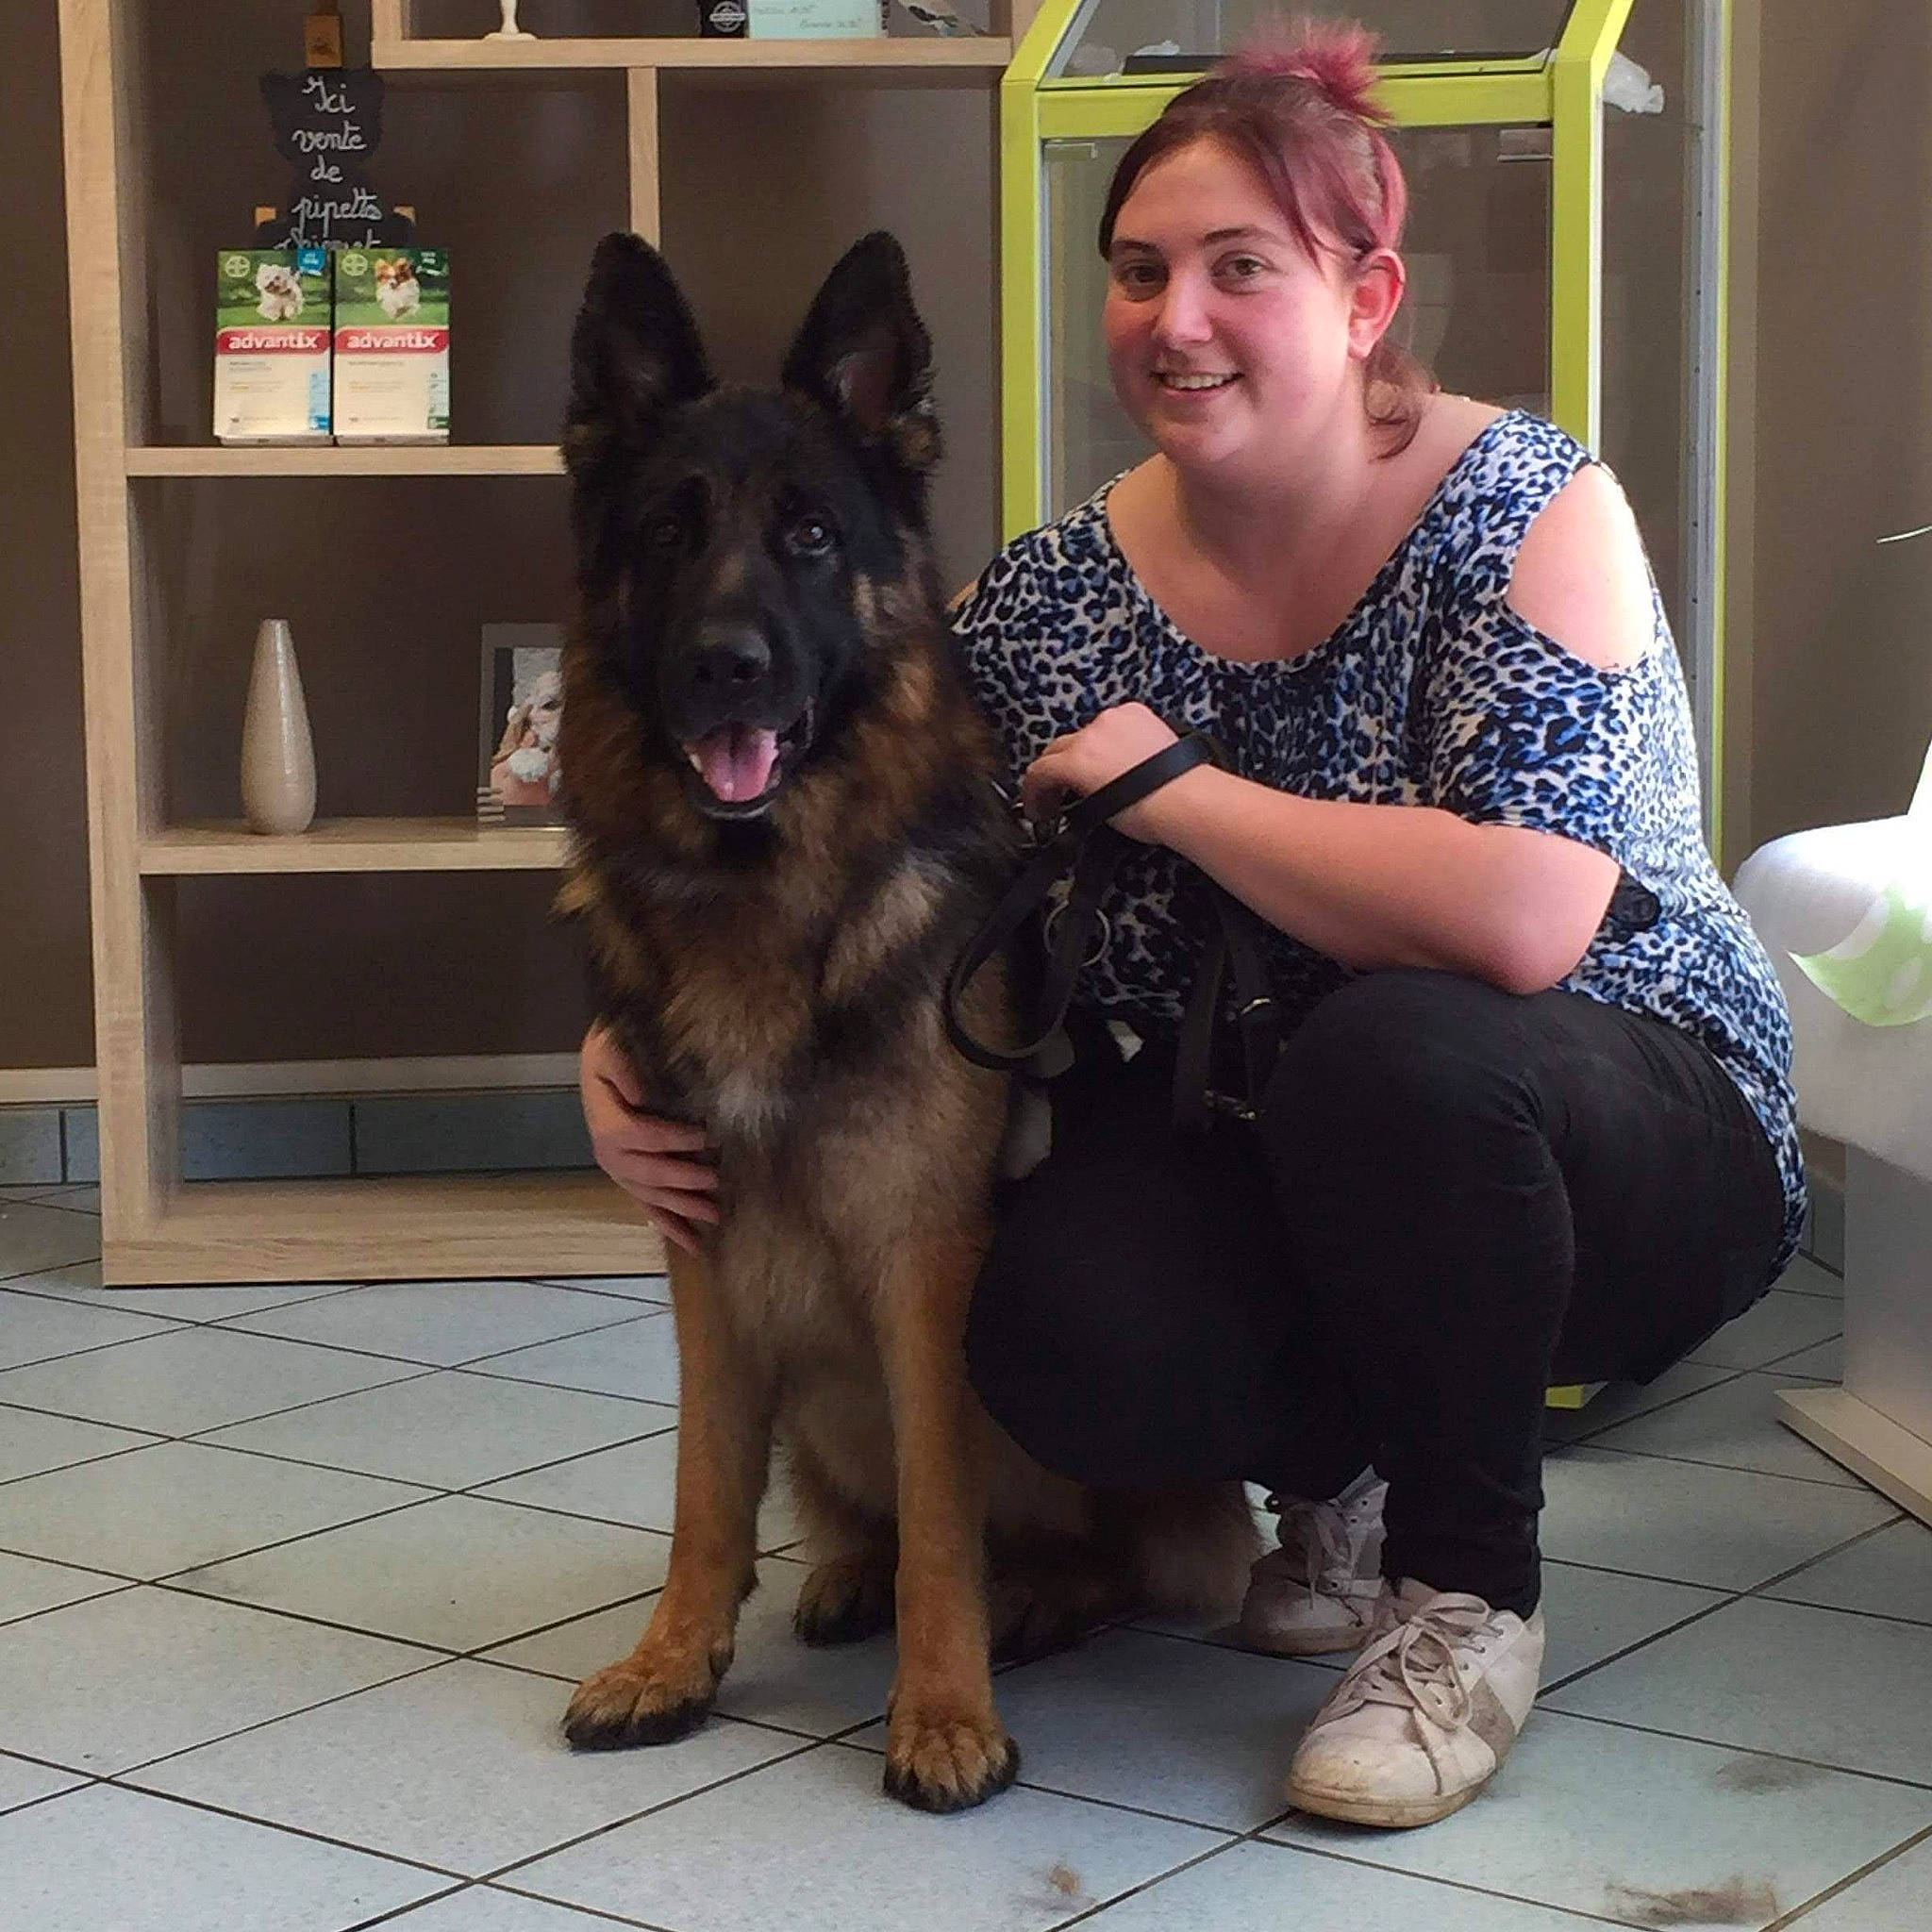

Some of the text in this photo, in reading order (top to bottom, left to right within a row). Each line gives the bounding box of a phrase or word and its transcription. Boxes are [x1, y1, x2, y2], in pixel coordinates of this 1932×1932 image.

[291, 119, 367, 152] vente
[309, 154, 343, 182] de
[228, 332, 321, 349] advantix
[347, 331, 440, 349] advantix
